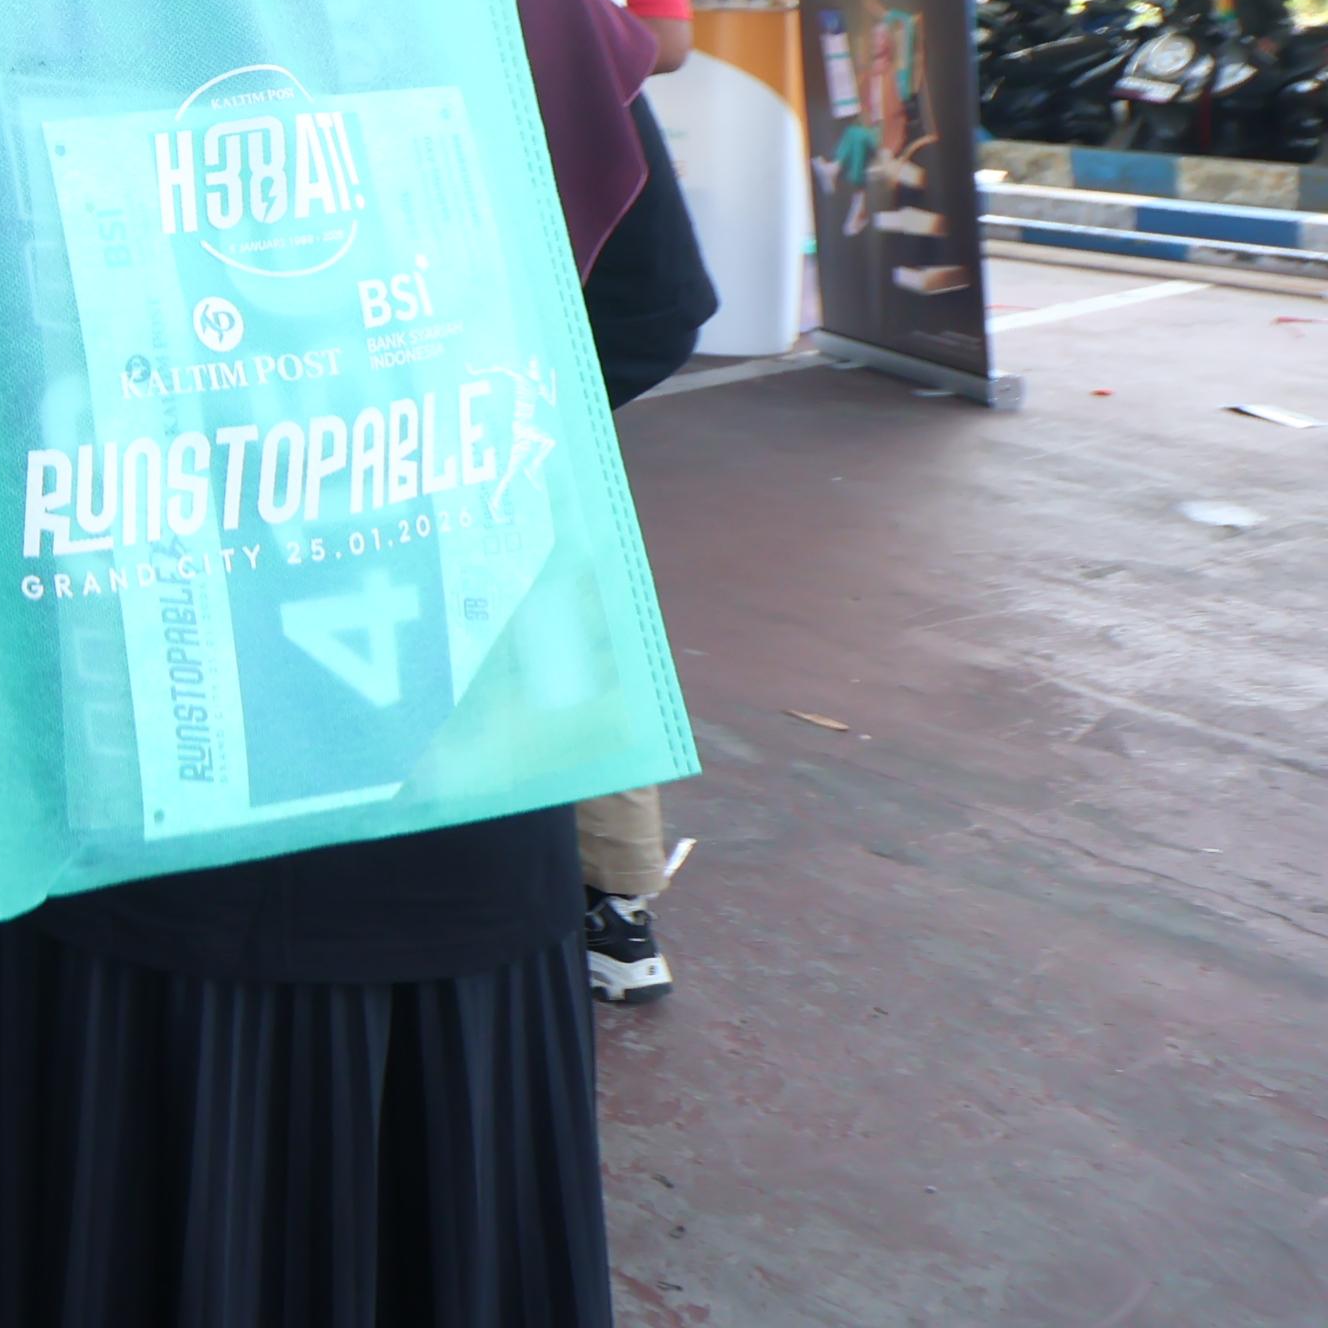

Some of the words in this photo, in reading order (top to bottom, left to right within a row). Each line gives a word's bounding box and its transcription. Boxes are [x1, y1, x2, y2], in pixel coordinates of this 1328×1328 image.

[357, 256, 433, 329] BSI
[120, 358, 249, 401] KALTIM
[252, 348, 342, 384] POST
[367, 330, 405, 353] BANK
[22, 381, 498, 558] RUNSTOPABLE
[20, 563, 158, 601] GRAND
[177, 544, 262, 582] CITY
[285, 510, 474, 566] 25.01.2026
